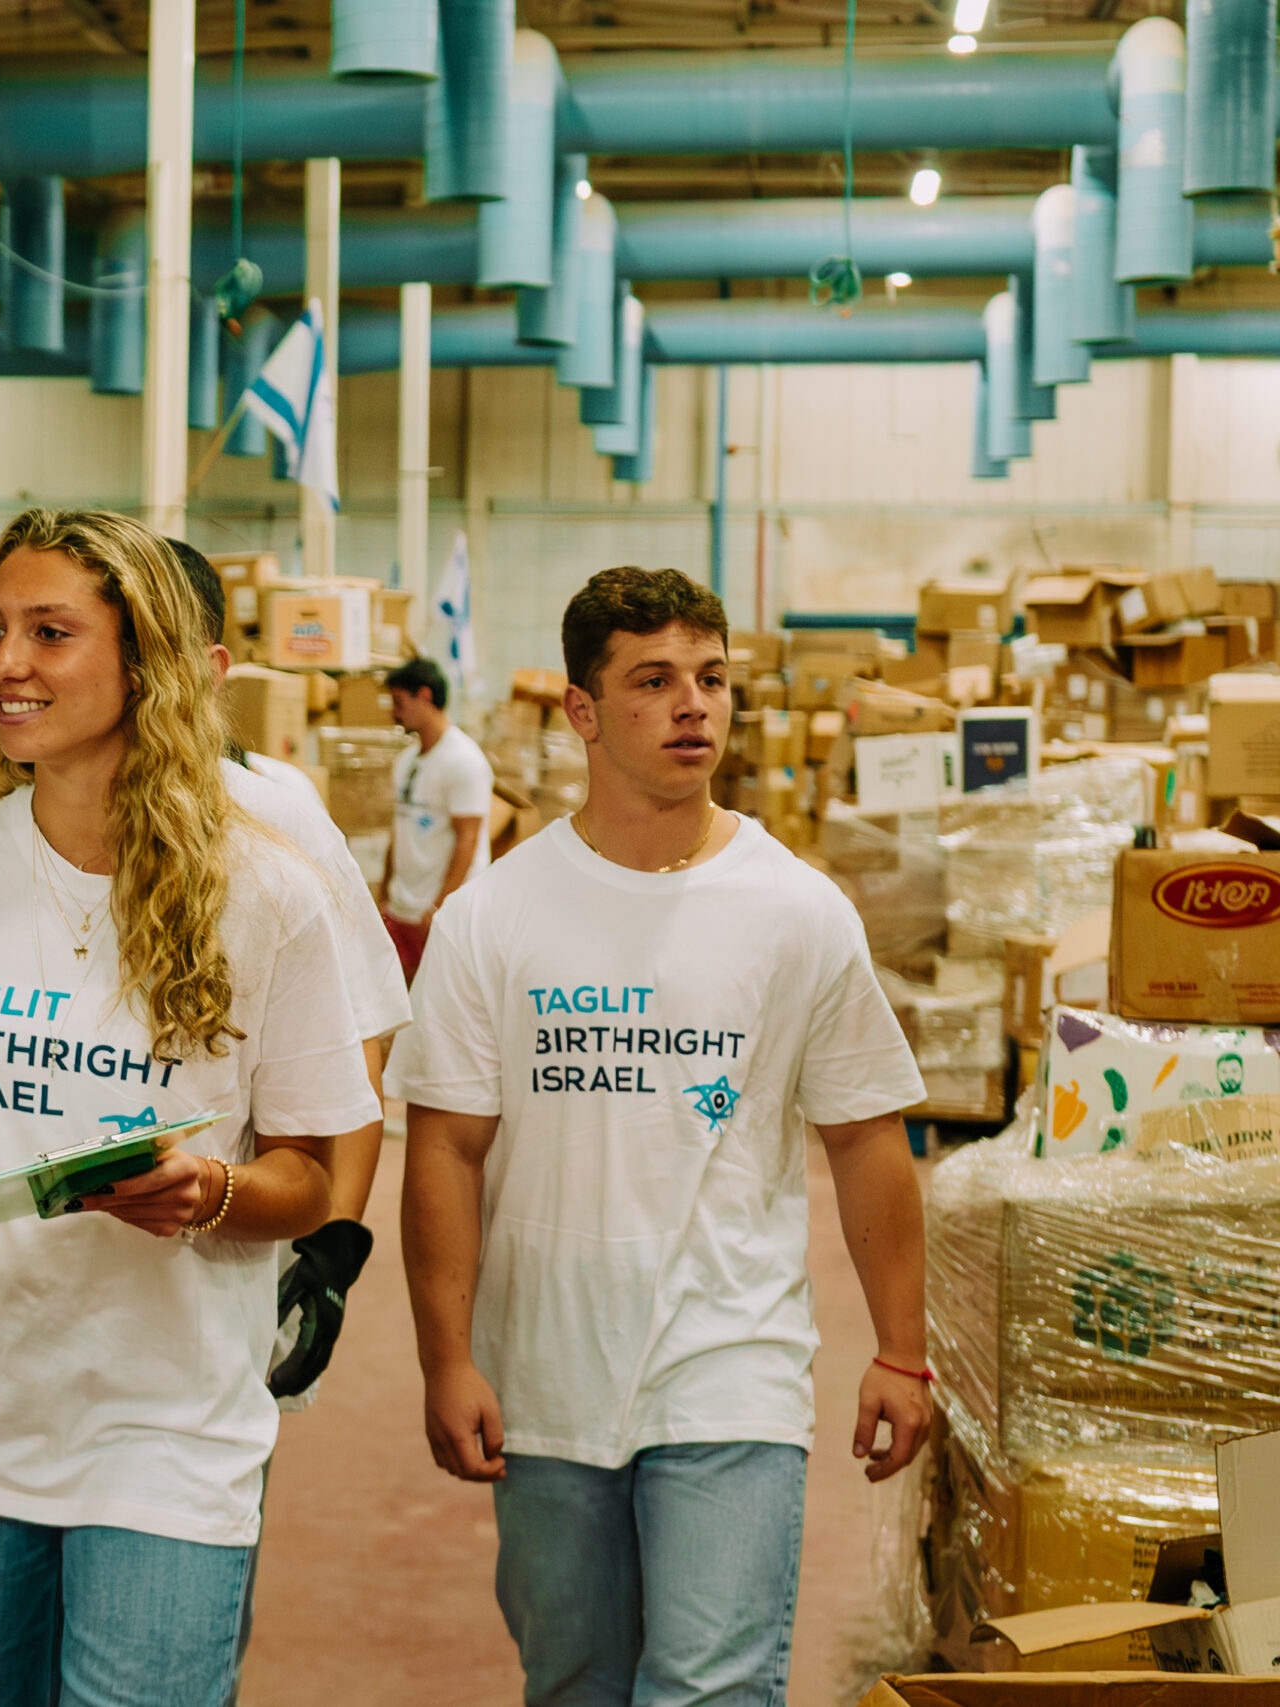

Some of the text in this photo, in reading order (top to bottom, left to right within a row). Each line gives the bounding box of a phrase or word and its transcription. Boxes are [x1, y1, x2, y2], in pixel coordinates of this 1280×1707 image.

[527, 985, 654, 1015] TAGLIT
[535, 1026, 746, 1059] BIRTHRIGHT
[532, 1065, 656, 1094] ISRAEL
